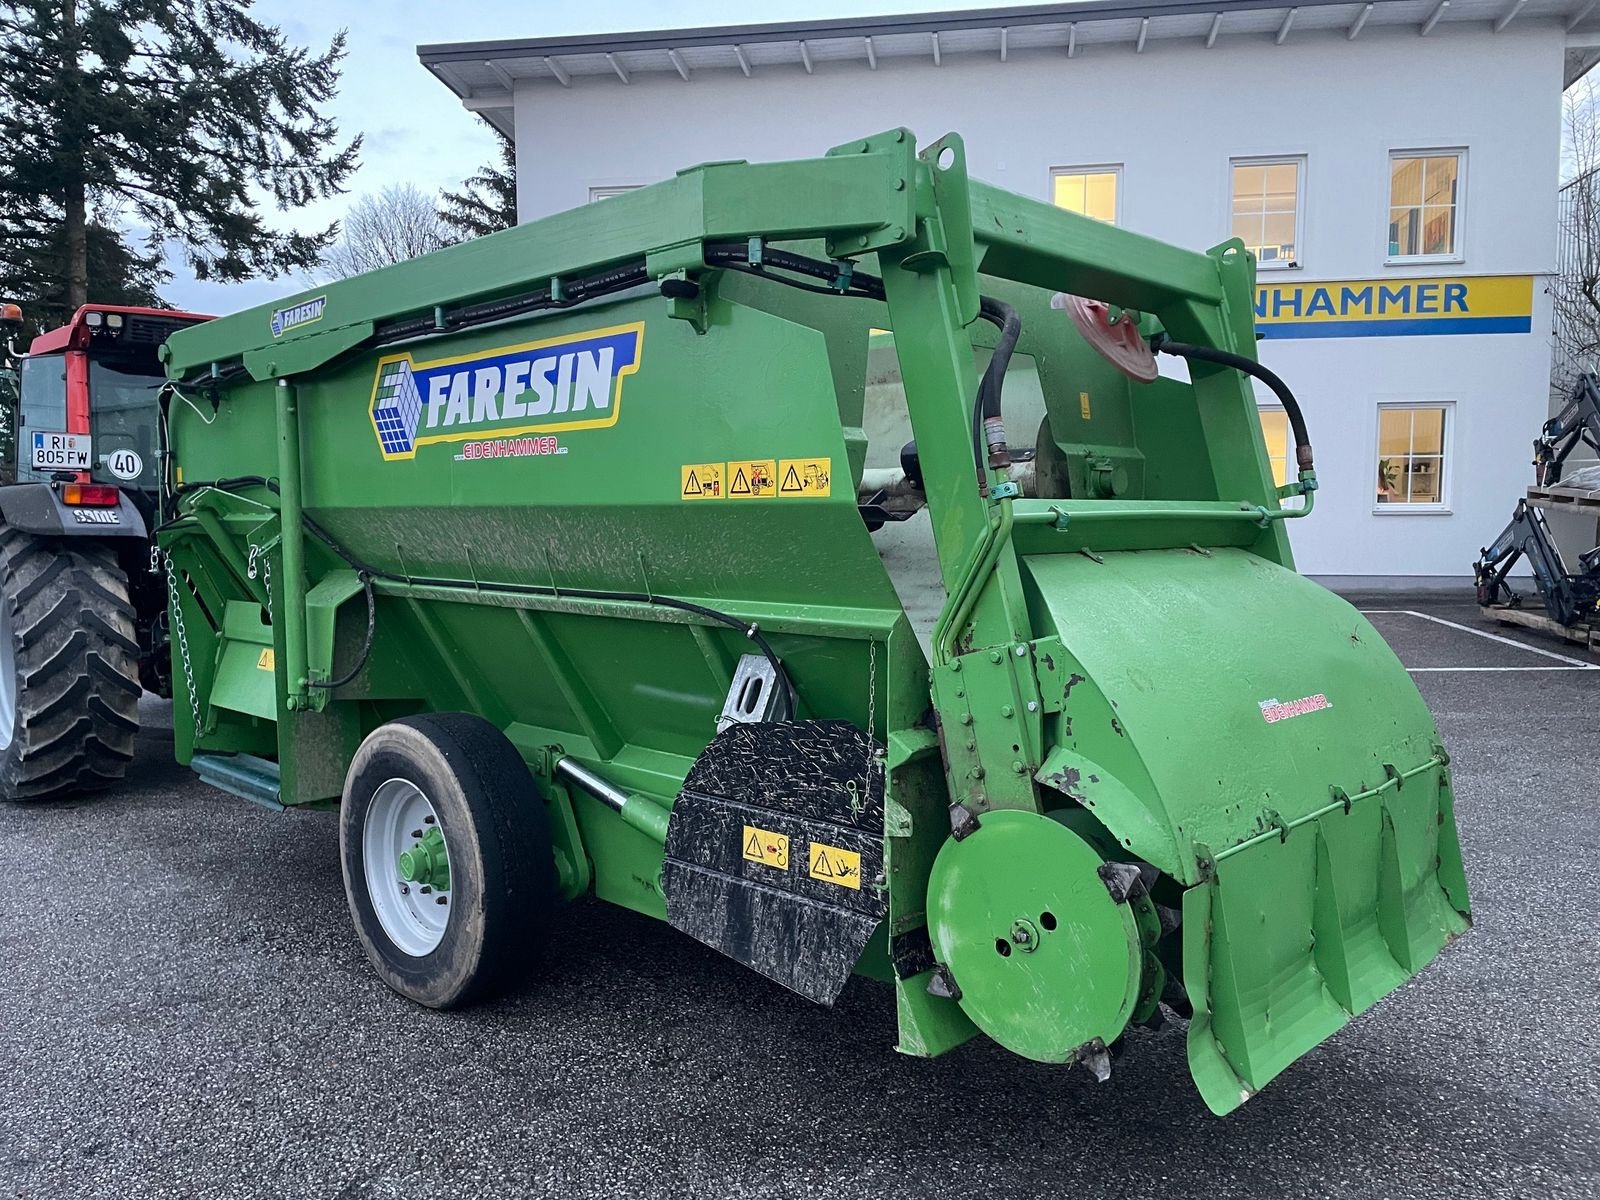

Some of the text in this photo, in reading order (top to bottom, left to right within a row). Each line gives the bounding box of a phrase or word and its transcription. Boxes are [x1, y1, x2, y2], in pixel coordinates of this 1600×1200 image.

[284, 300, 322, 327] FARESIN
[426, 347, 614, 428] FARESIN
[52, 436, 65, 449] RI
[463, 436, 558, 459] EIDENHAMMER
[37, 450, 88, 465] 805 FW
[115, 454, 134, 473] 40
